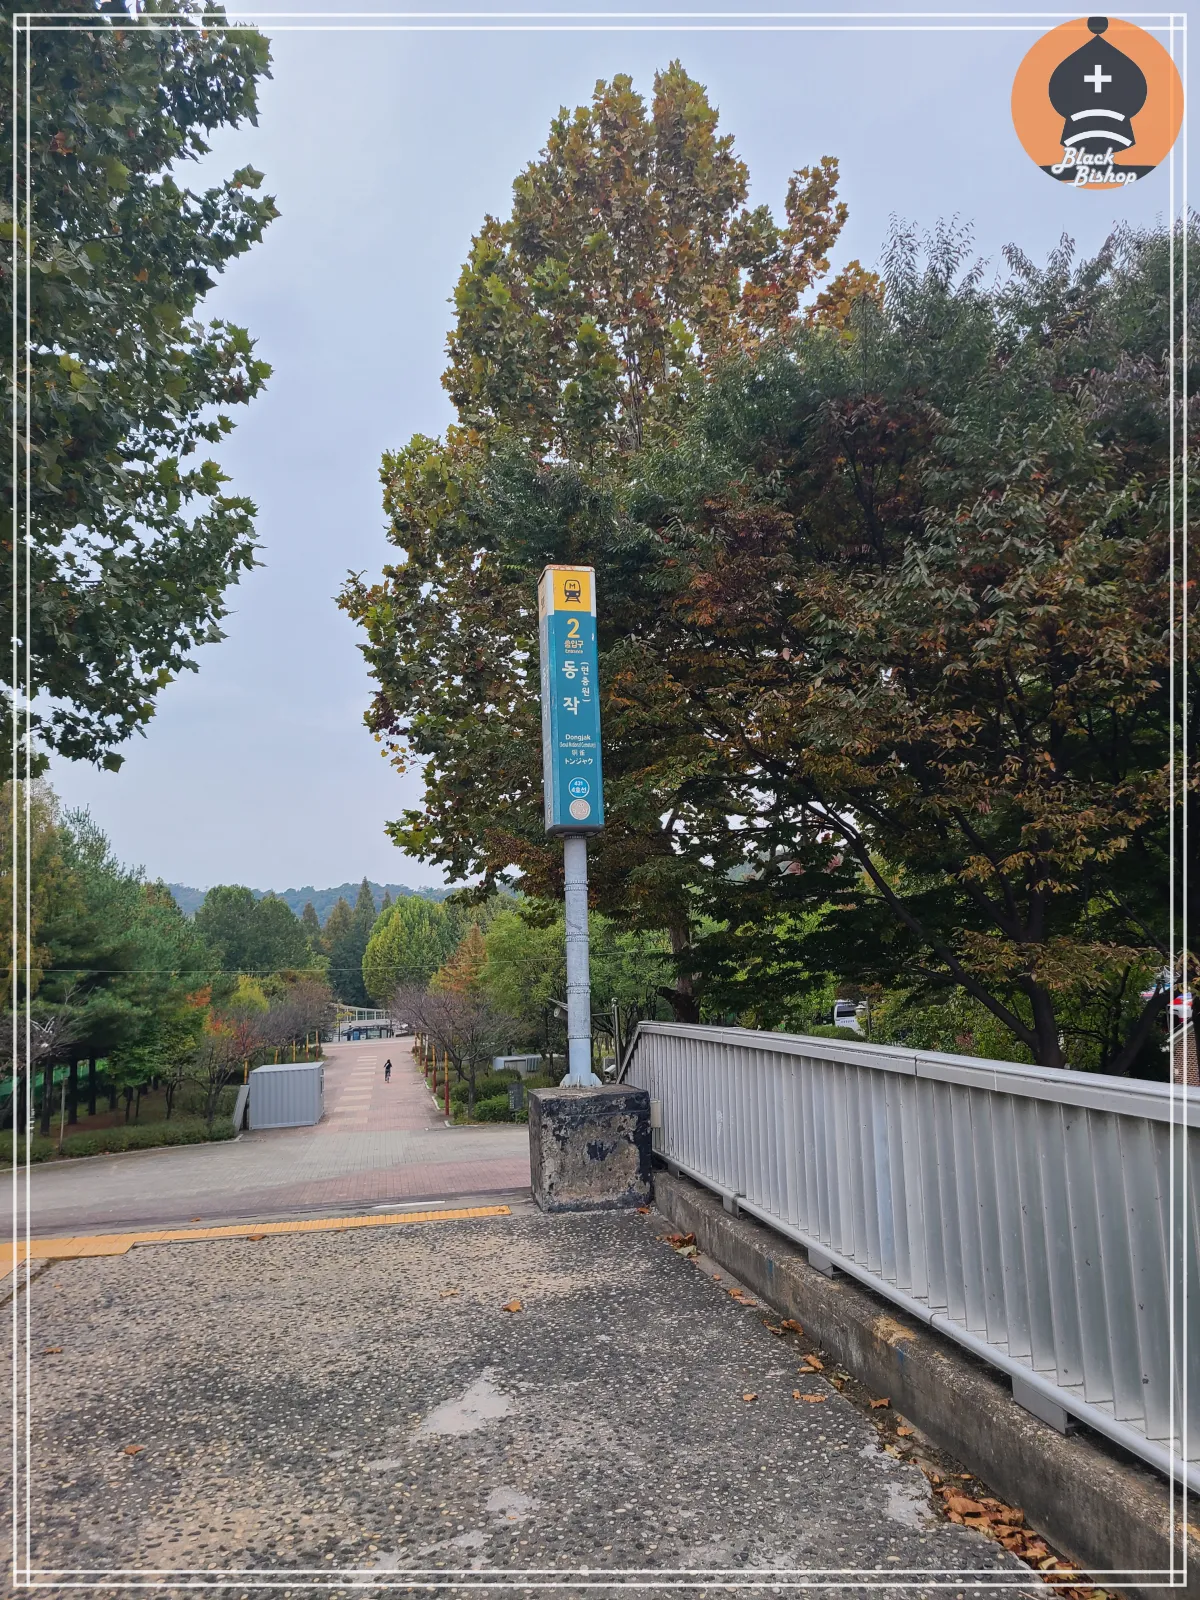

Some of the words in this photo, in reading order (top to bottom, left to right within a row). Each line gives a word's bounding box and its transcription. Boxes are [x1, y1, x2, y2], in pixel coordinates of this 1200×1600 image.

[567, 618, 580, 638] 2
[564, 640, 584, 649] 출입구
[565, 757, 593, 765] トンジャク
